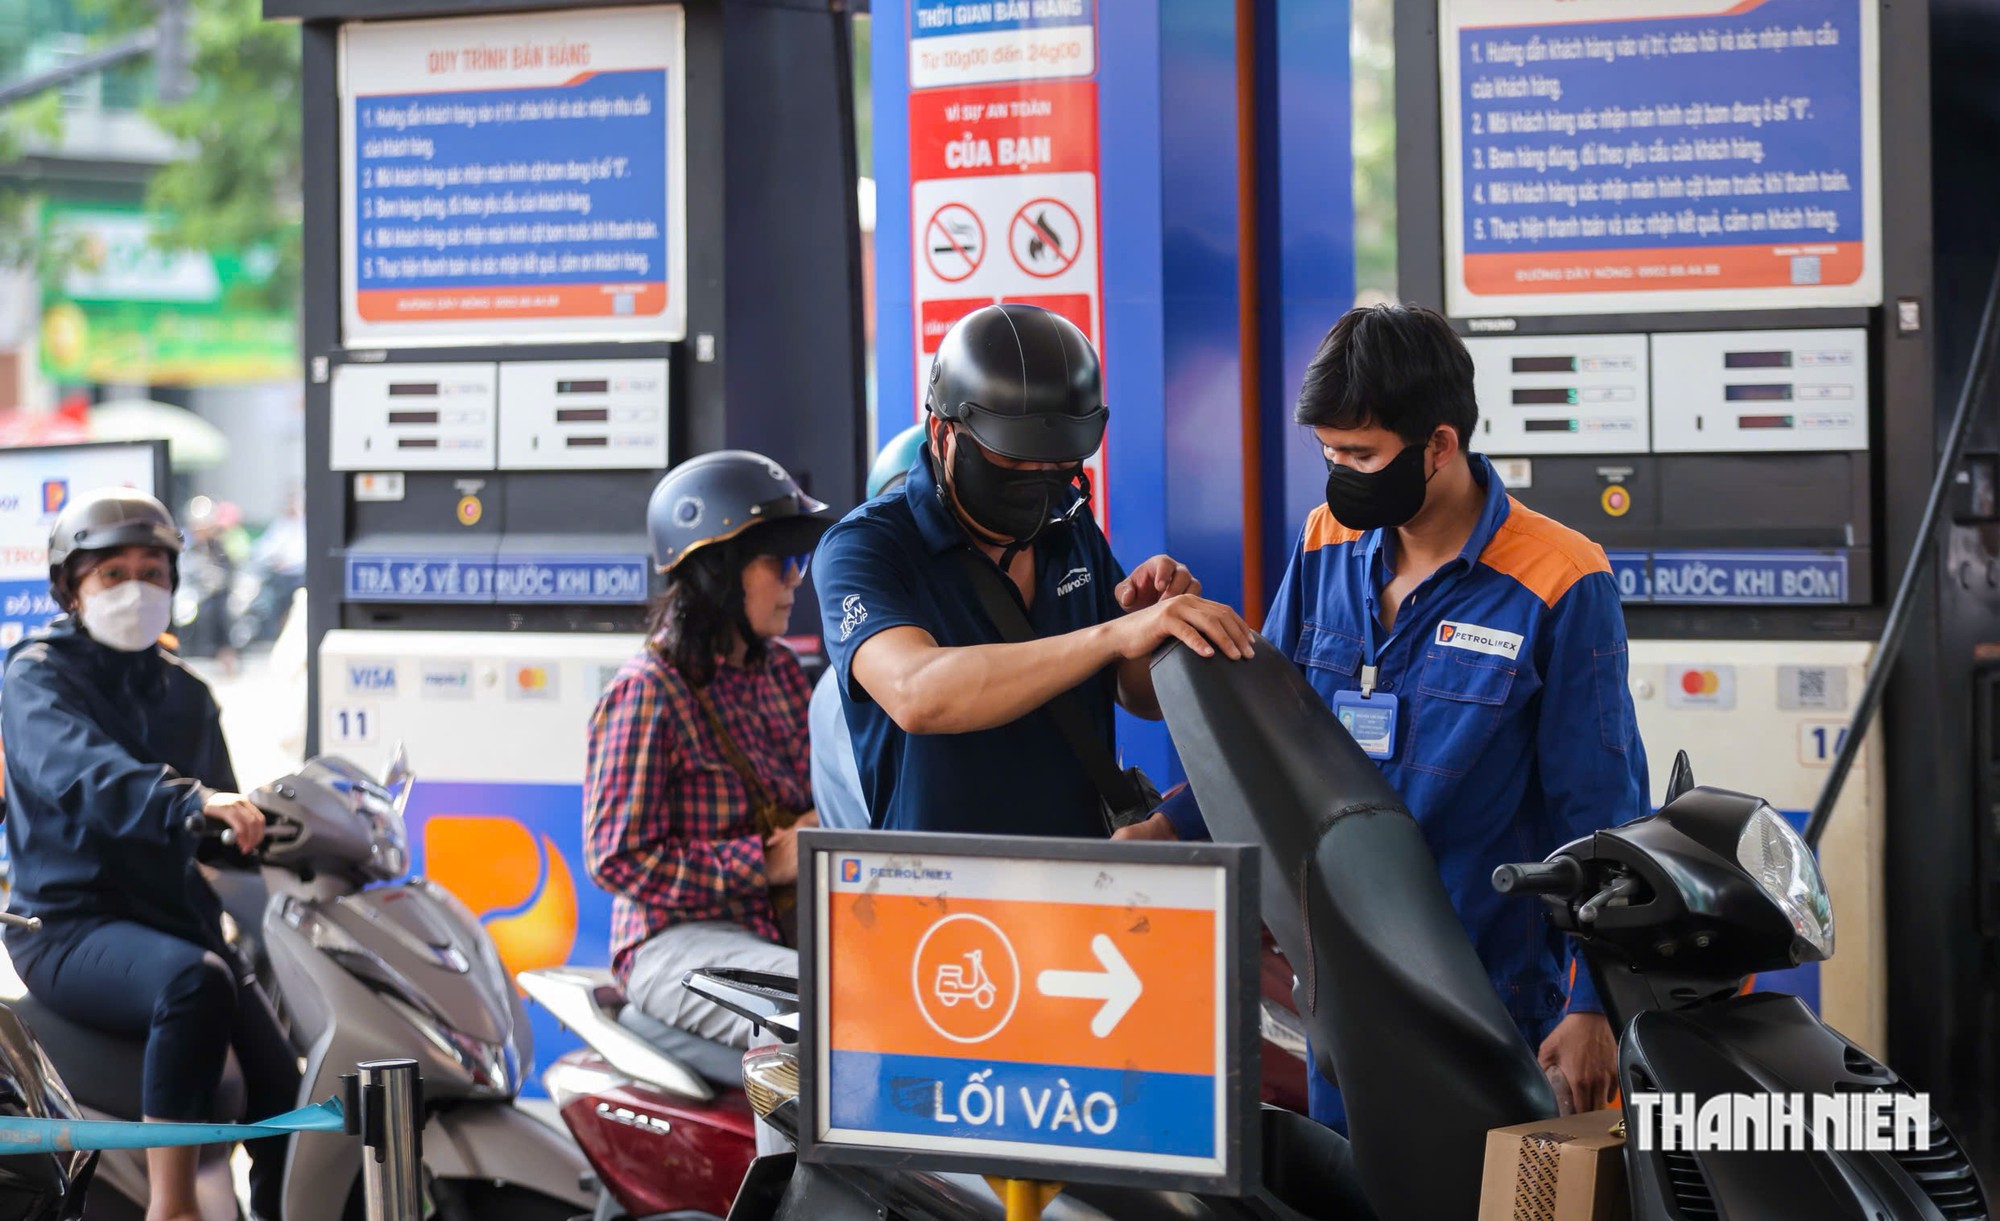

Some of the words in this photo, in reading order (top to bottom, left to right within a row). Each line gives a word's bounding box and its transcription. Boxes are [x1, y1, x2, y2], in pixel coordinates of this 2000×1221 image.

[917, 6, 953, 29] THỜI
[954, 4, 992, 25] GIAN
[945, 103, 960, 122] VÌ
[962, 103, 982, 124] SỰ
[986, 103, 1008, 120] AN
[1010, 99, 1052, 118] TOÀN
[945, 132, 993, 170] CỦA
[997, 136, 1050, 171] BẠN
[358, 559, 395, 593] TRẢ
[399, 559, 427, 594] SỐ
[431, 559, 460, 594] VỀ
[482, 562, 553, 595] TRƯỚC
[557, 568, 590, 595] KHI
[594, 565, 640, 595] BƠM
[1620, 568, 1636, 593] 0
[1733, 568, 1774, 595] KHI
[1782, 566, 1838, 596] BƠM
[1455, 632, 1517, 651] PETROLIMEX
[350, 667, 396, 688] VISA
[338, 710, 368, 737] 11
[934, 1068, 1004, 1126] LỐI
[1020, 1078, 1118, 1134] VÀO
